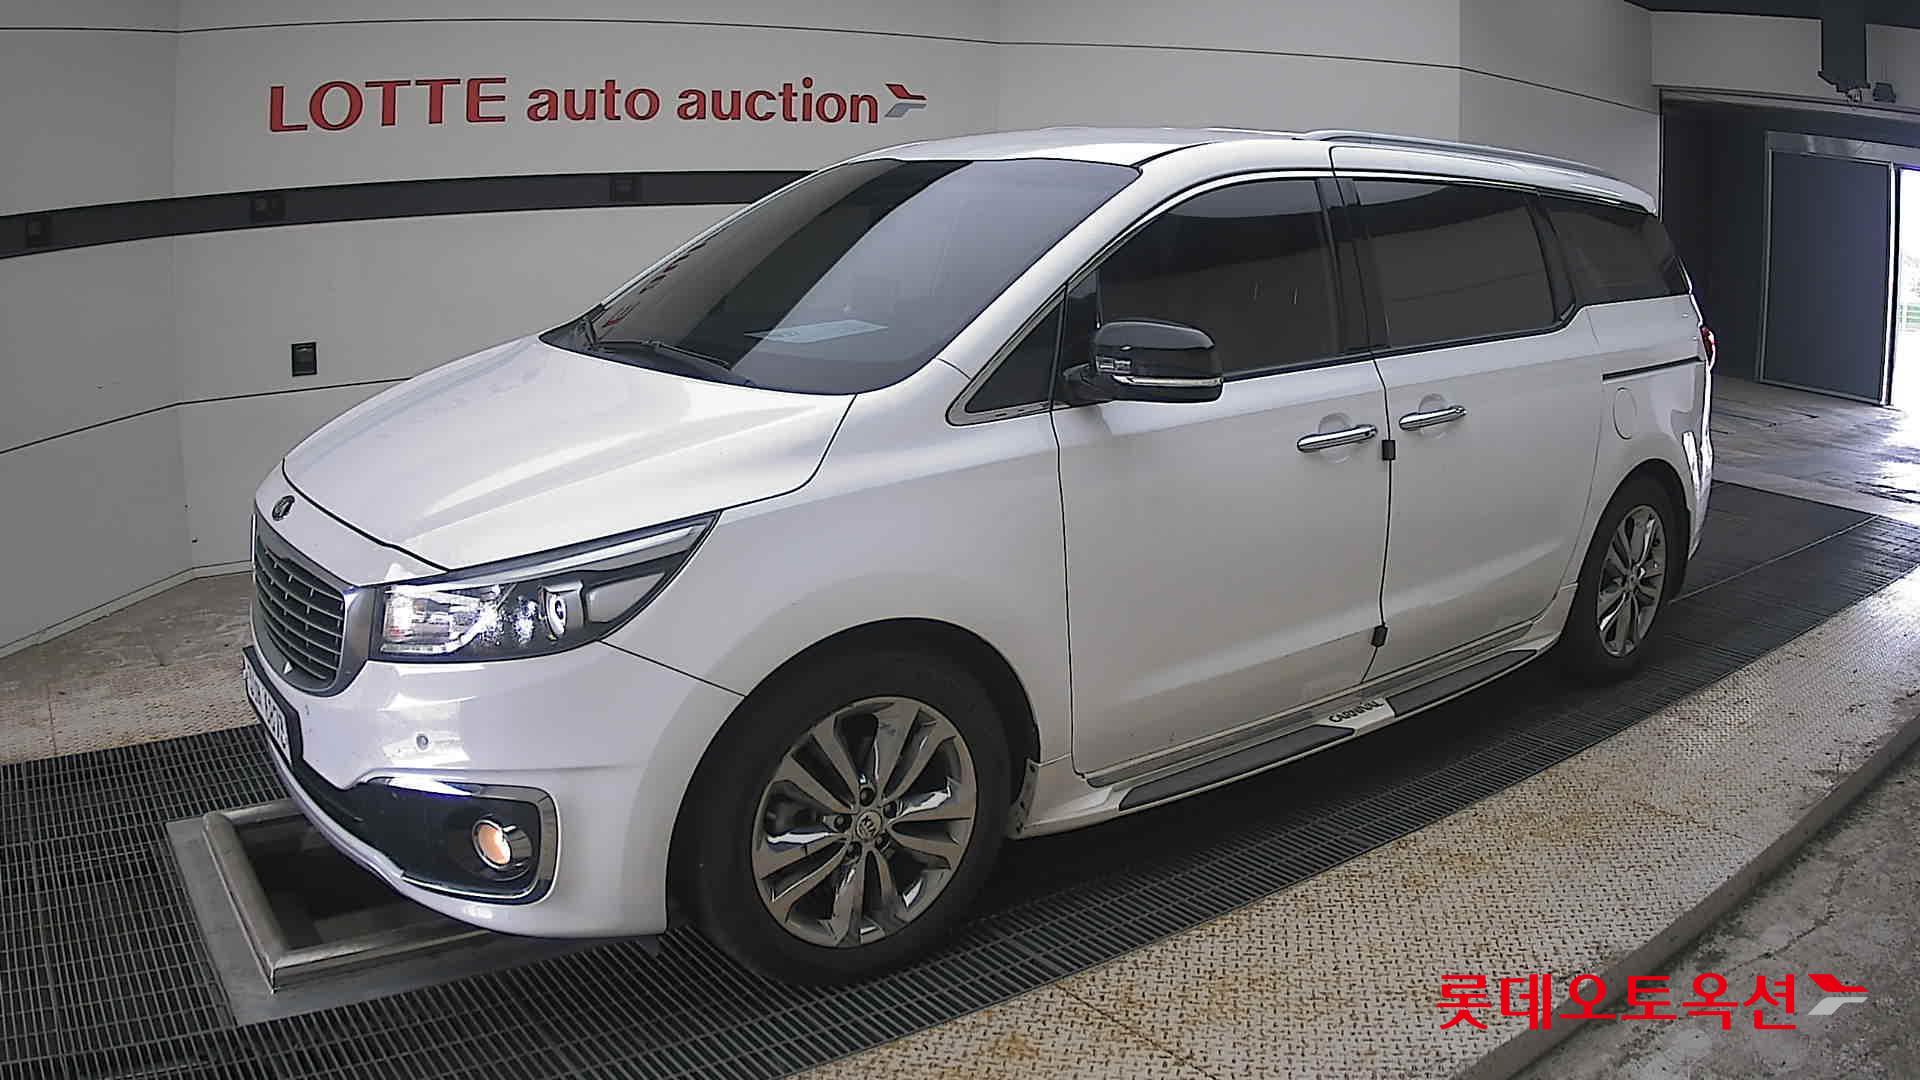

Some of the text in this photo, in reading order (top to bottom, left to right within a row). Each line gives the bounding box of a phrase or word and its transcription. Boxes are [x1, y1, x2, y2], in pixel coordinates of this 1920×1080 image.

[268, 77, 879, 133] LOTTE auto auction
